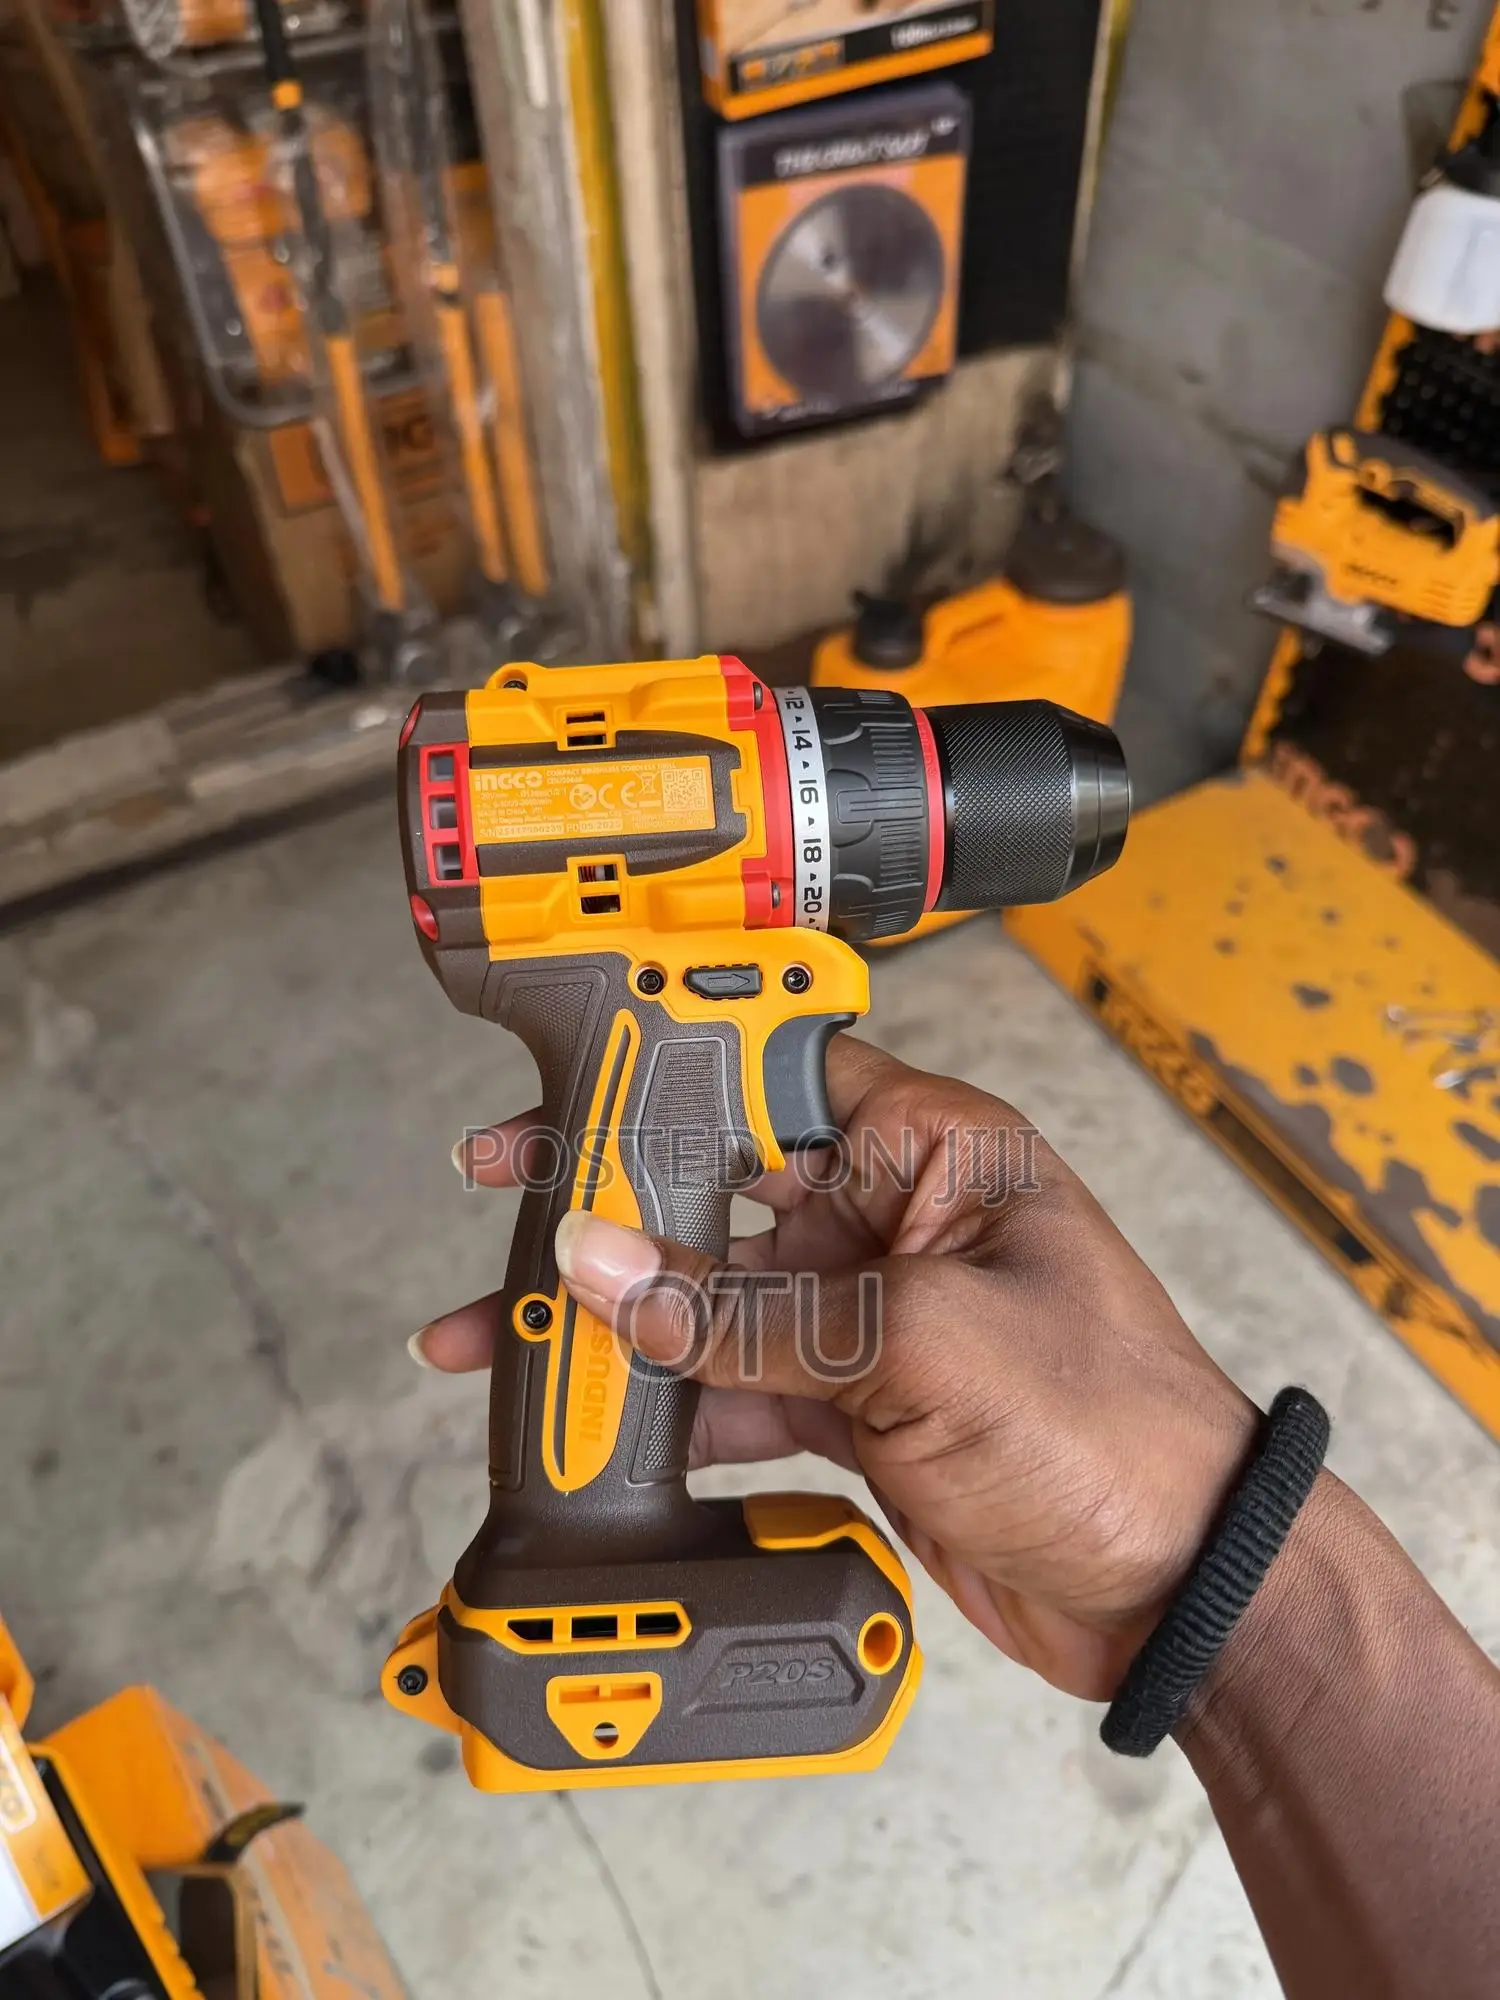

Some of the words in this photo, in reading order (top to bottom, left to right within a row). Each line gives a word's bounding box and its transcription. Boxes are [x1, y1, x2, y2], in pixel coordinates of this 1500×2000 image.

[784, 697, 805, 710] 12
[791, 729, 813, 751] 14
[546, 768, 580, 777] COMPACT
[620, 762, 657, 772] CORDLESS
[798, 779, 819, 805] 16
[802, 838, 822, 864] 18
[803, 886, 823, 914] 20
[720, 1656, 835, 1687] P20S
